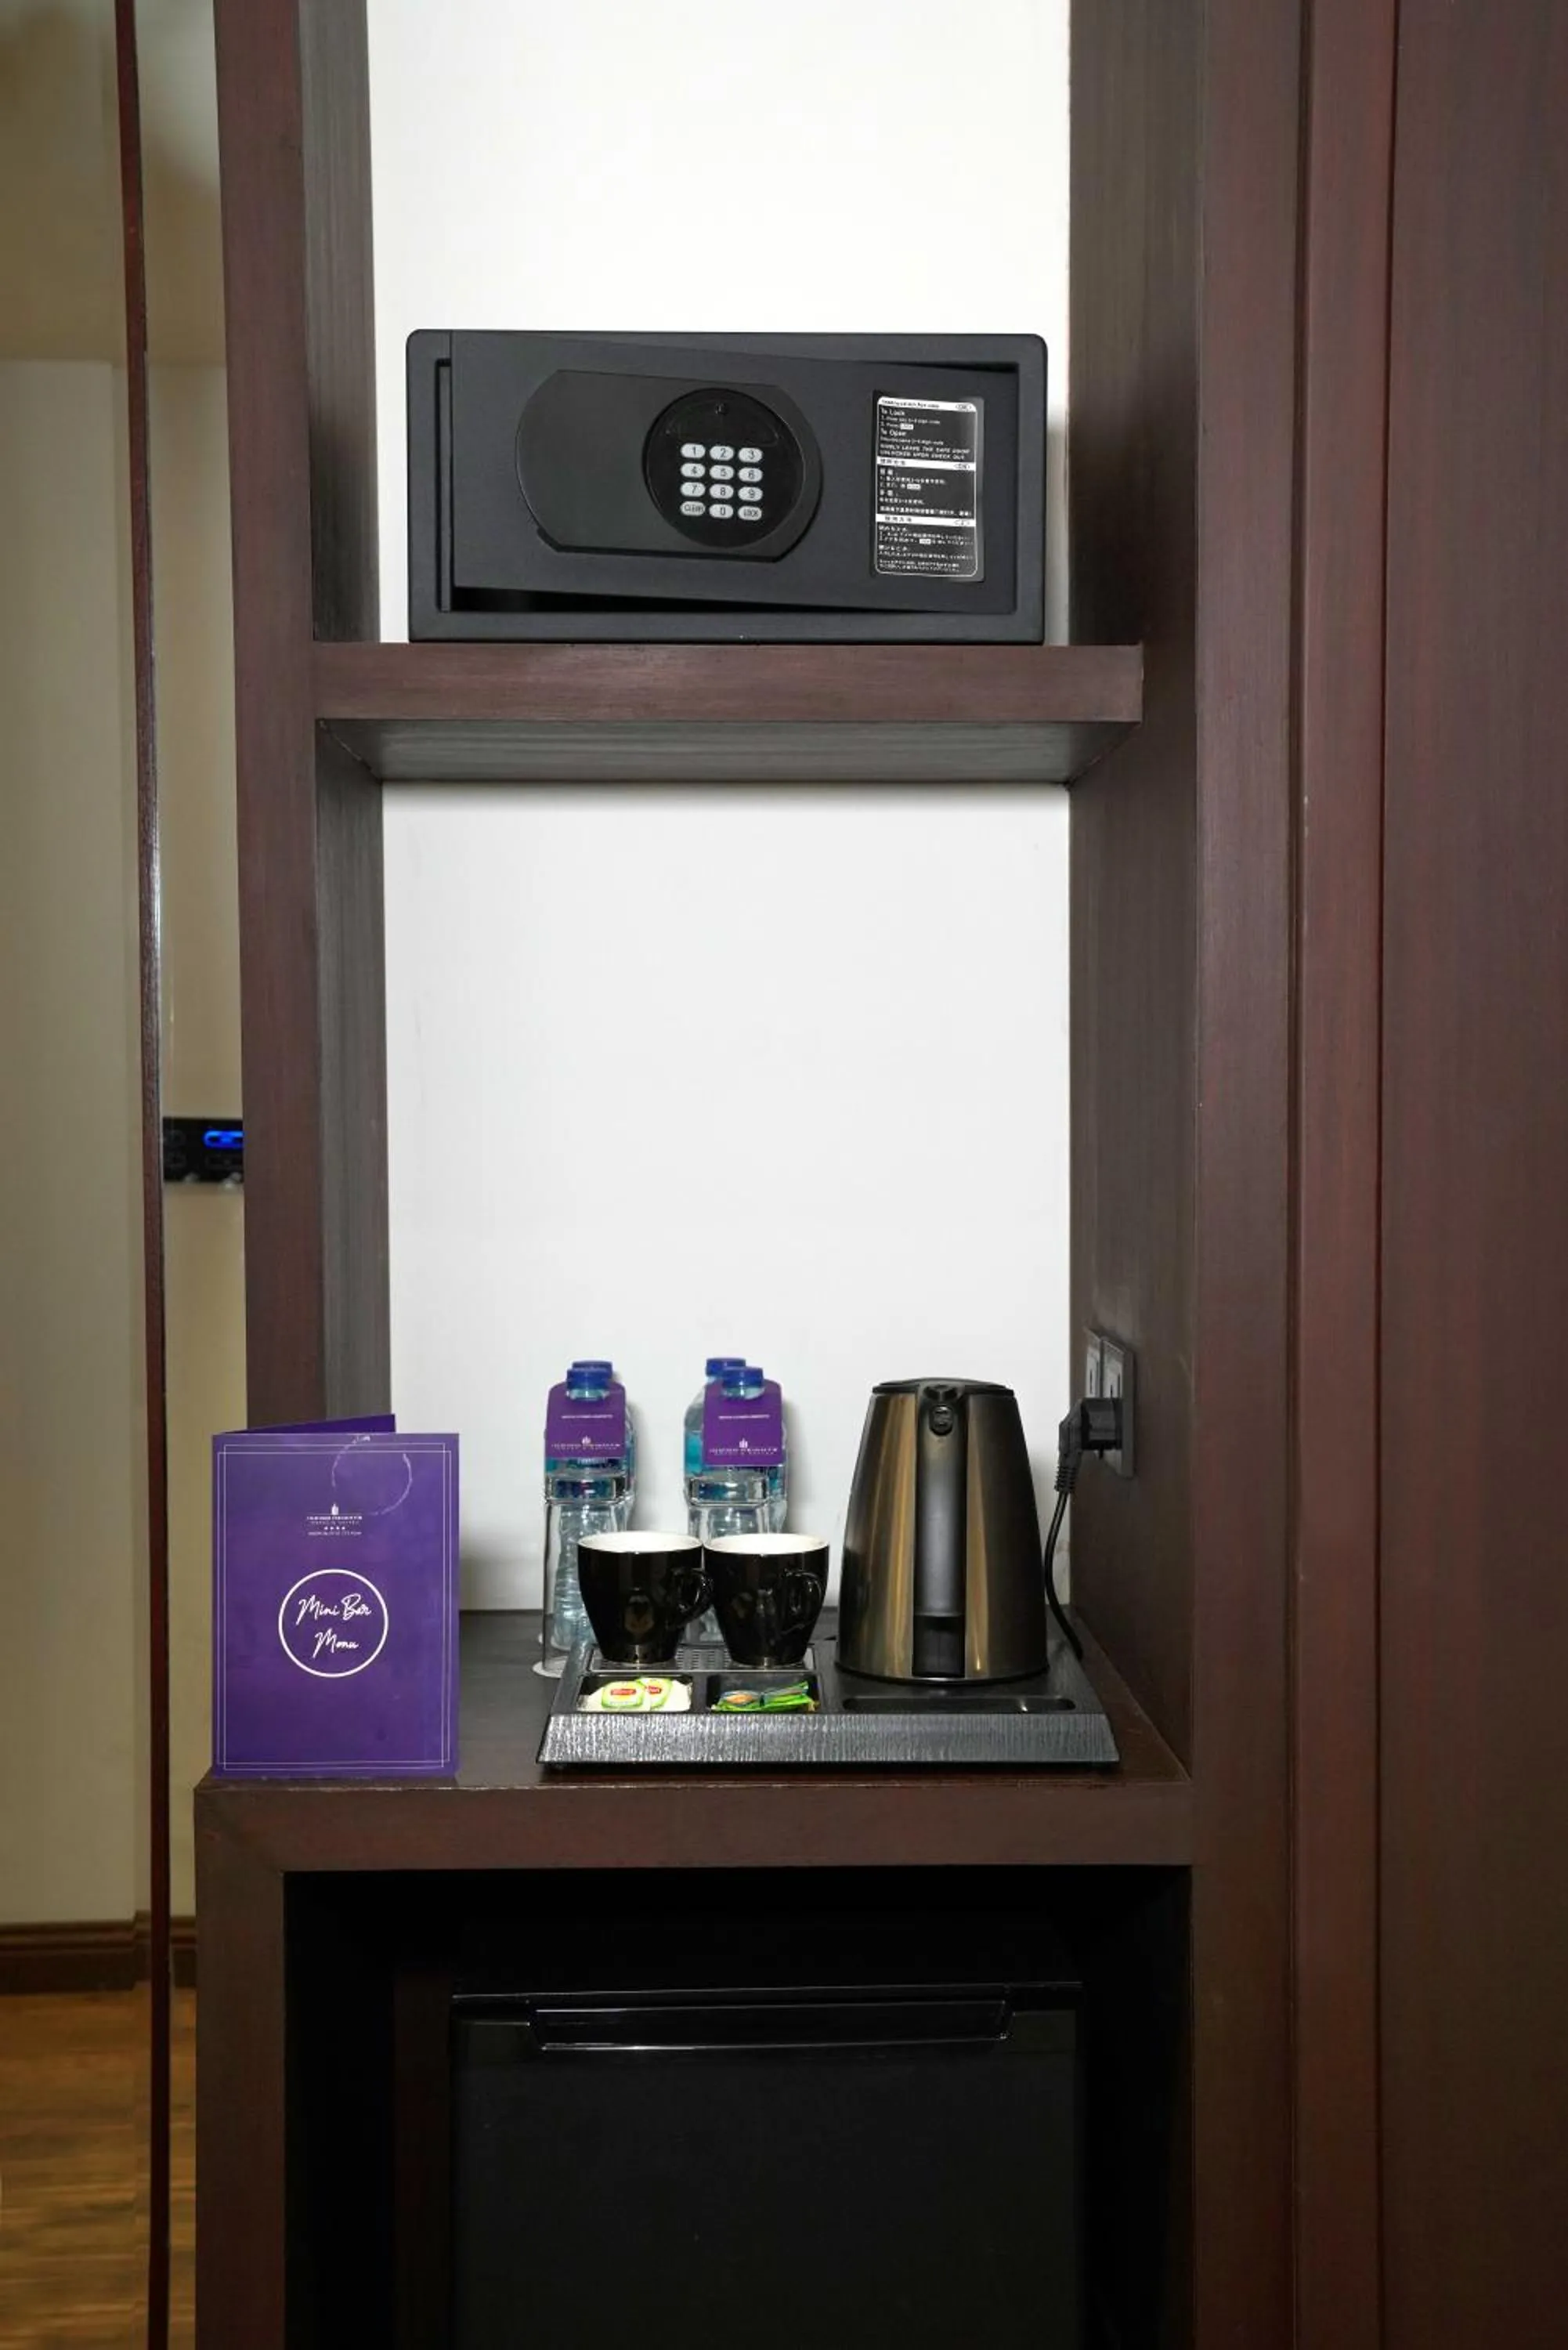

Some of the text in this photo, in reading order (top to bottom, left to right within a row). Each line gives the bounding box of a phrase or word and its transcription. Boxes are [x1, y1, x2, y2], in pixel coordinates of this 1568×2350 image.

[295, 1593, 372, 1625] Mini Bar
[313, 1628, 359, 1658] Menu
